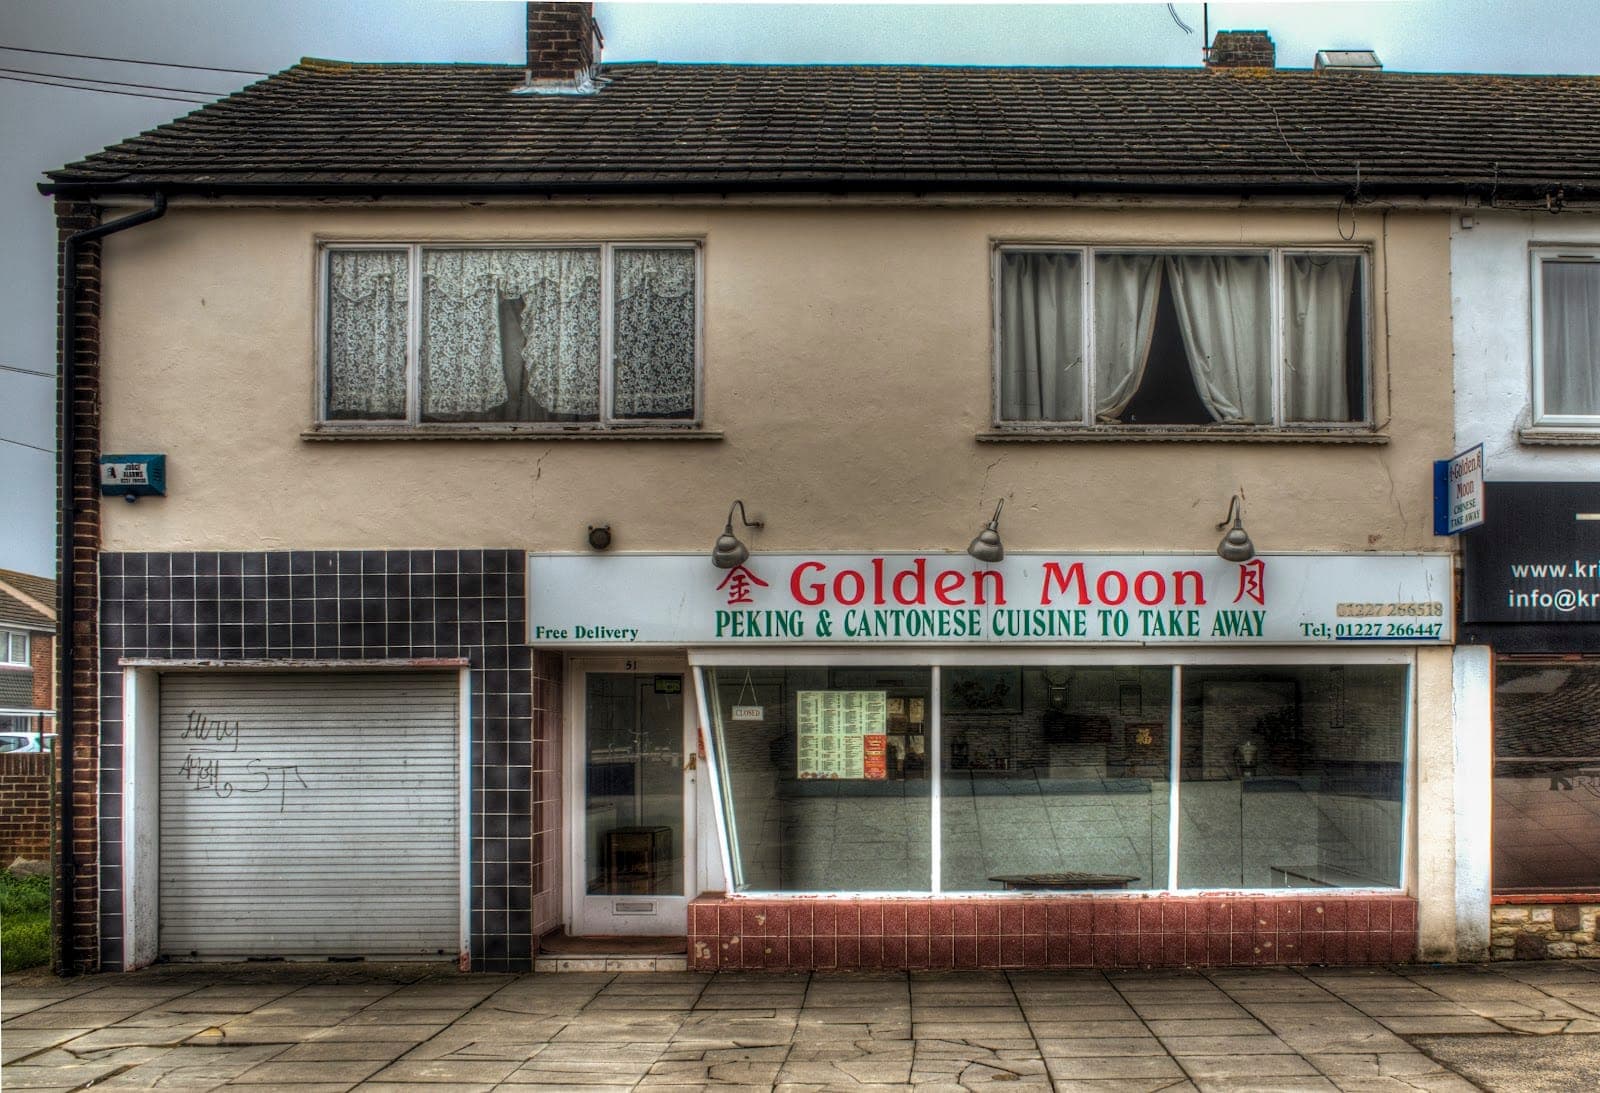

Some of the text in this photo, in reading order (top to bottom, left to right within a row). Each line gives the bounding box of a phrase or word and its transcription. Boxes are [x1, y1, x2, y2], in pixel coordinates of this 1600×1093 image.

[1454, 457, 1476, 479] Golden
[1456, 480, 1474, 499] Moon
[1453, 498, 1476, 515] CHINESE
[1451, 509, 1480, 528] TAKE AWAY
[716, 558, 1265, 606] 金 Golden Moon 月
[715, 609, 1267, 638] PEKING & CANTONESE CUISINE TO TAKE AWAY
[1335, 623, 1382, 637] 01227
[1387, 623, 1443, 637] 266447
[535, 625, 640, 641] Free Delivery
[625, 660, 637, 670] 51
[735, 708, 760, 718] CLOSED
